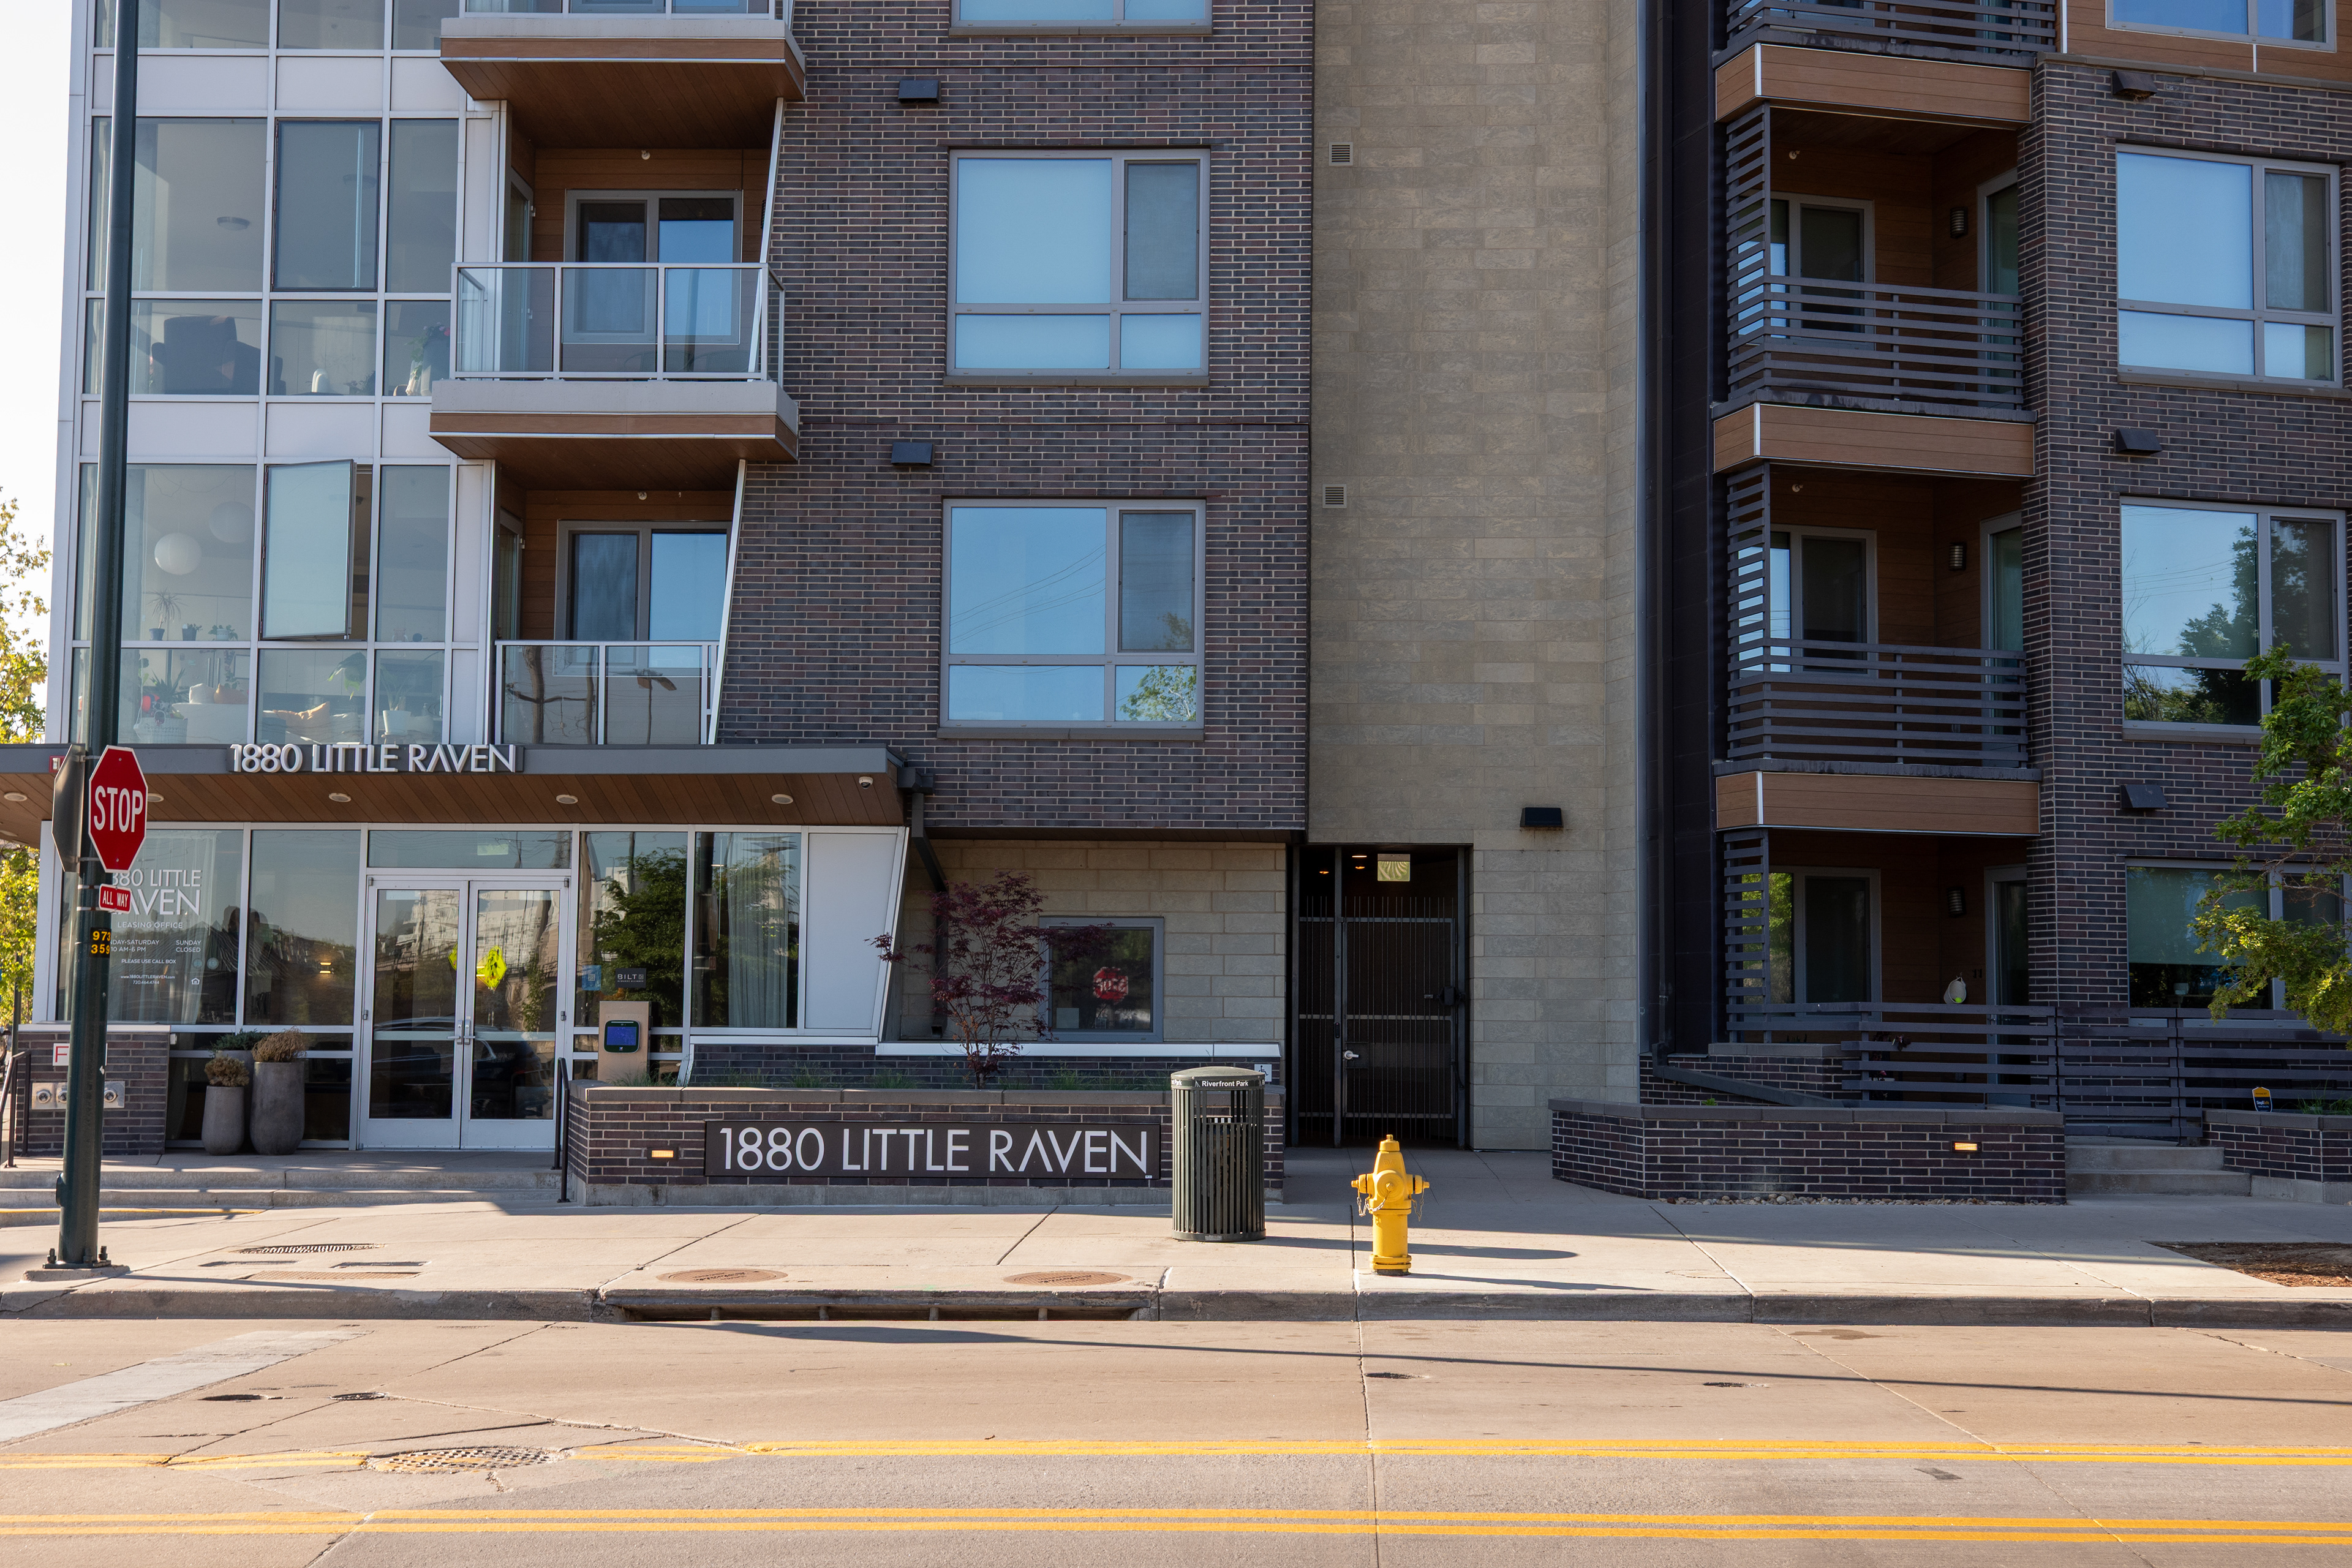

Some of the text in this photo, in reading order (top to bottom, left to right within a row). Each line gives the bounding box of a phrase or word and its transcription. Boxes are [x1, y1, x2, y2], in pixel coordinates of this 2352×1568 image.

[230, 743, 516, 773] 1880 LITTLE RAVEN
[94, 785, 143, 832] STOP
[150, 869, 202, 887] LITTLE
[102, 890, 129, 908] ALL WAY
[130, 889, 201, 916] AVEN
[92, 930, 111, 941] 973
[91, 944, 110, 955] 359
[720, 1127, 1147, 1174] 1880 LITTLE RAVEN
